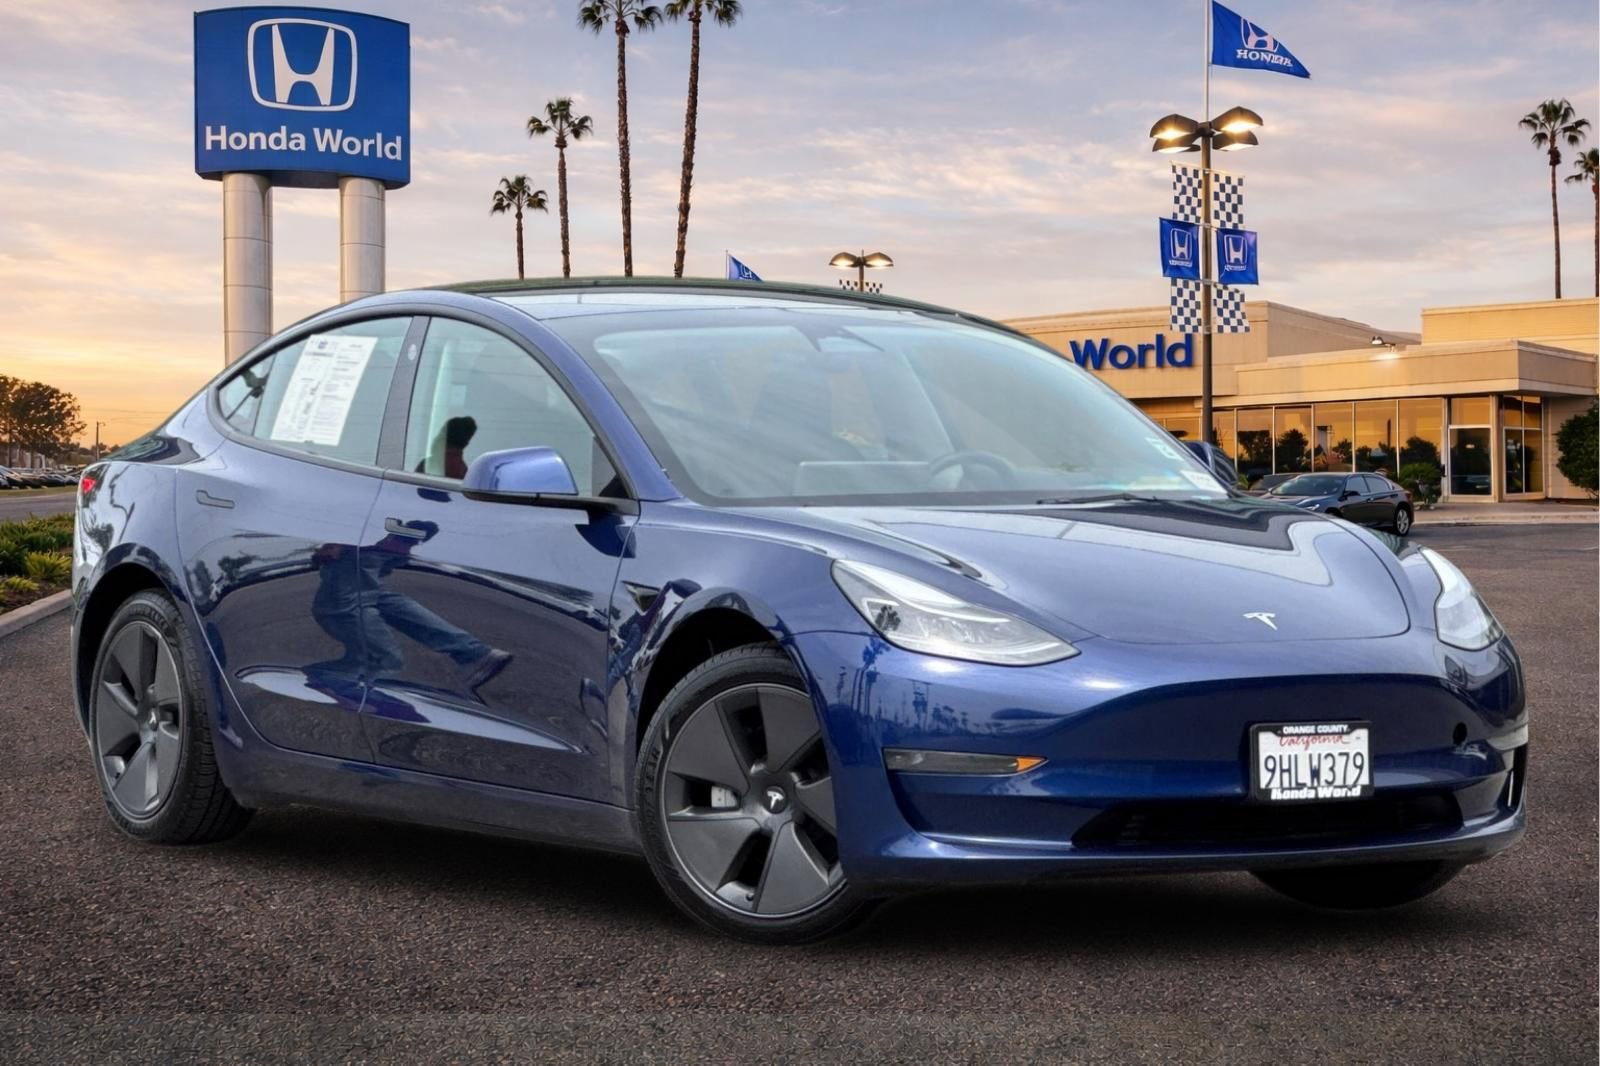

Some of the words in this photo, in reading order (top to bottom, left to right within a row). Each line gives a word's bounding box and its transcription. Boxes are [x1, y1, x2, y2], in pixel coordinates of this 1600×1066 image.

[205, 125, 306, 152] Honda
[313, 127, 402, 161] World
[1069, 333, 1194, 370] World
[1317, 724, 1349, 733] COUNTY
[1264, 752, 1365, 789] 9HLW379
[1270, 788, 1317, 800] Honda
[1317, 786, 1362, 799] World
